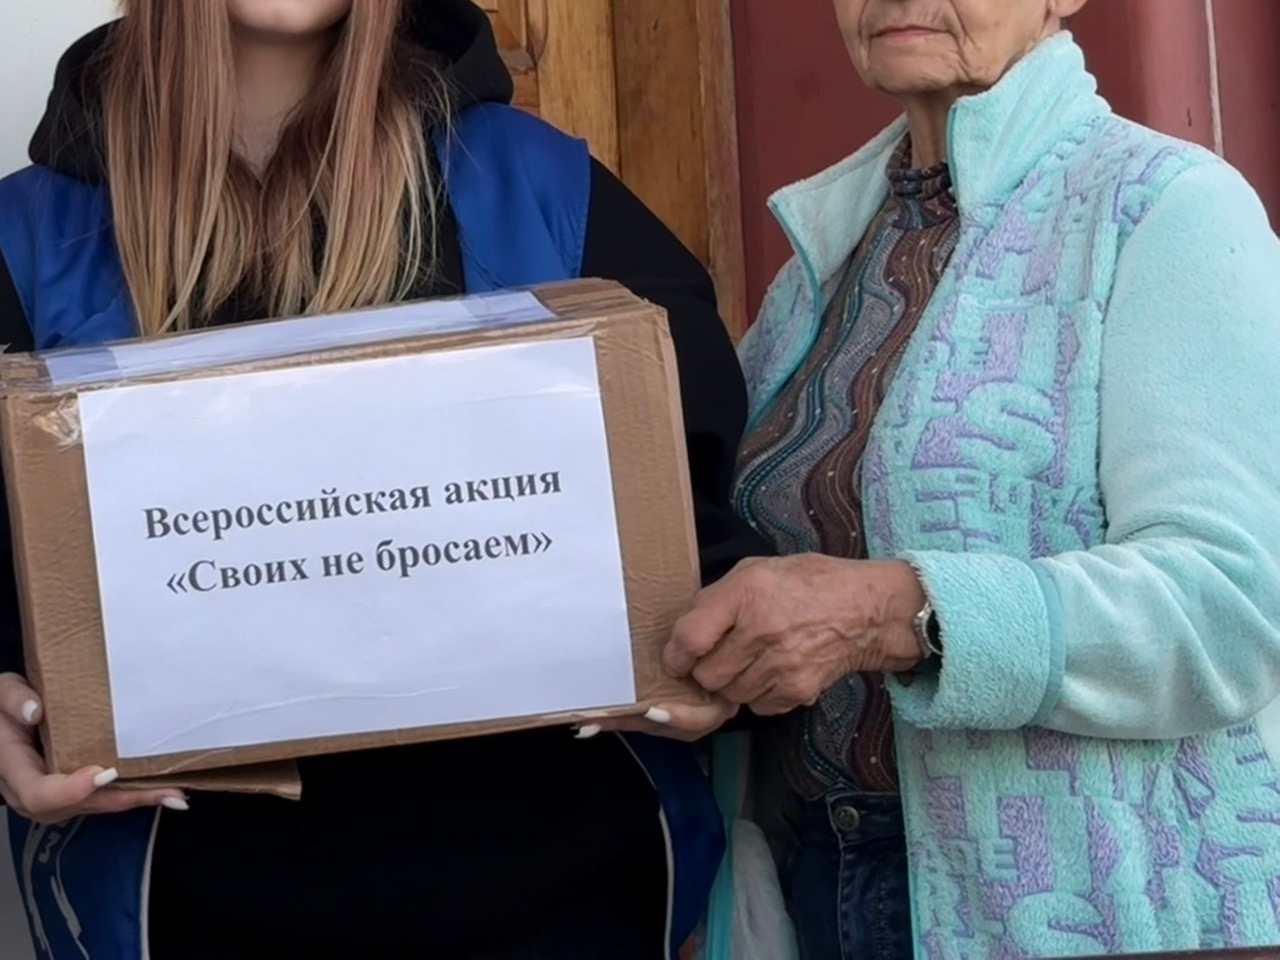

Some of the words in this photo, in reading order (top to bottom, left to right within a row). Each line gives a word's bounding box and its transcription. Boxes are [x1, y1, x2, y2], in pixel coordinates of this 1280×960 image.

[143, 485, 432, 541] Всероссийская
[444, 470, 563, 505] акция
[165, 557, 310, 595] «Своих
[321, 551, 365, 578] не
[374, 530, 554, 578] бросаем»
